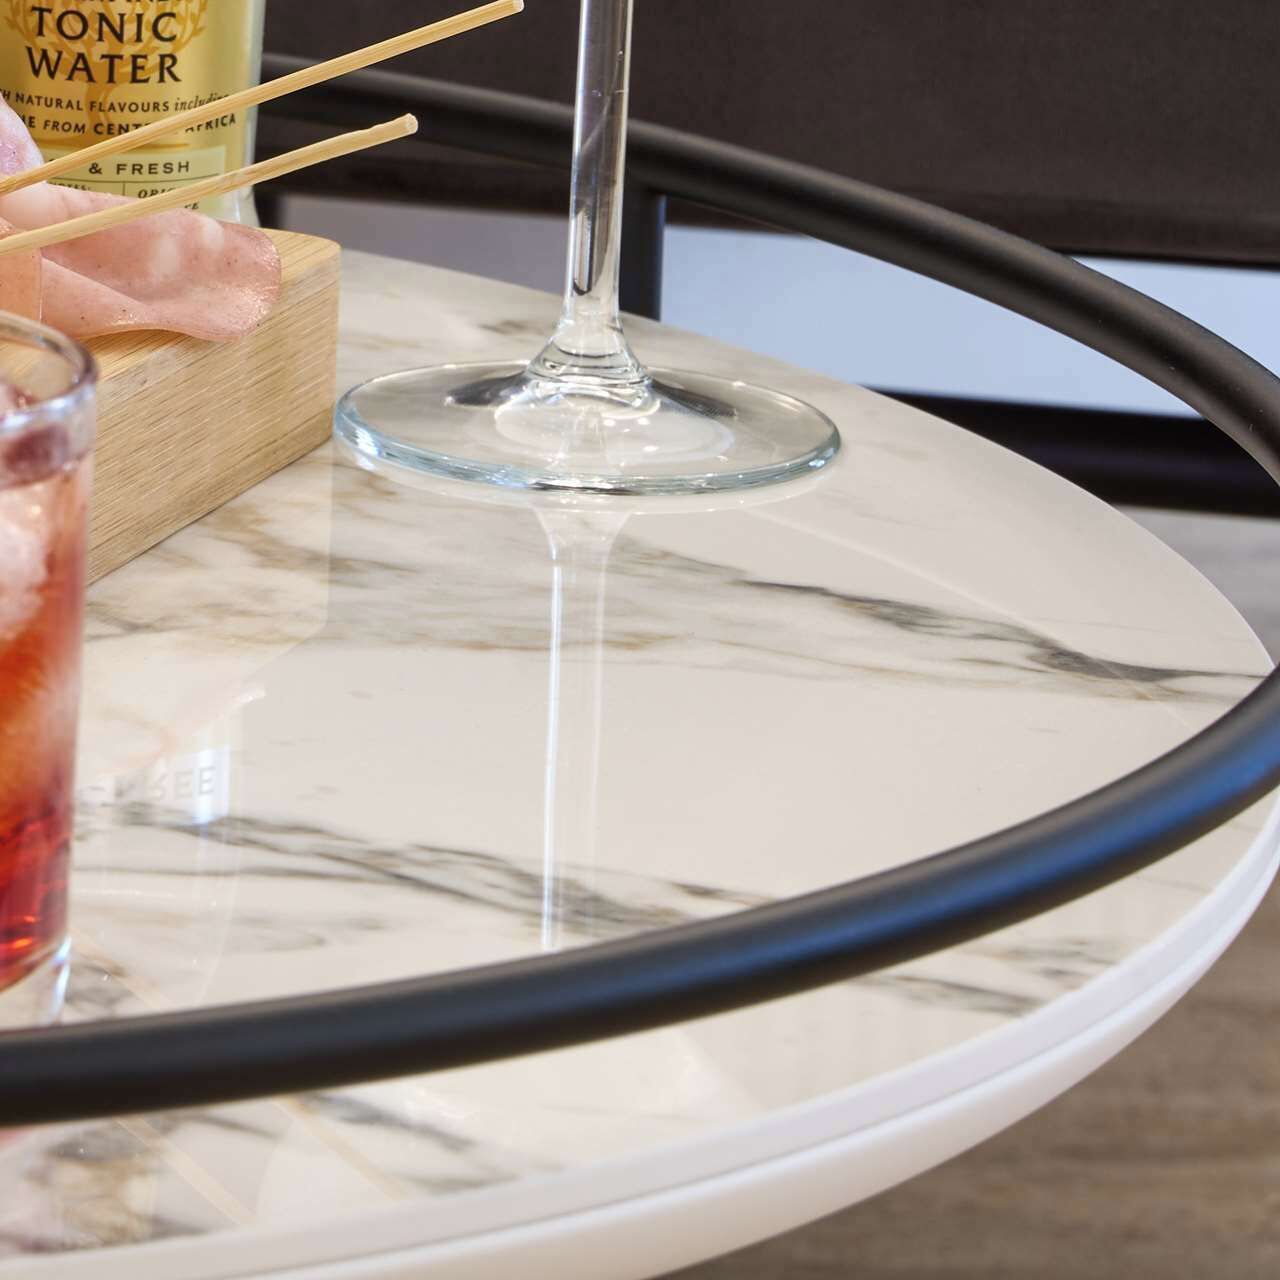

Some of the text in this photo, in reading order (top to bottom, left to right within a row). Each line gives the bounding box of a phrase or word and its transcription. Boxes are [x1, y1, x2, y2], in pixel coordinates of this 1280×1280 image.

[31, 6, 177, 44] TONIC
[25, 46, 183, 84] WATER
[15, 91, 83, 111] NATURAL
[89, 100, 170, 113] FLAVOURS
[43, 117, 87, 134] FROM
[88, 161, 190, 175] & FRESH
